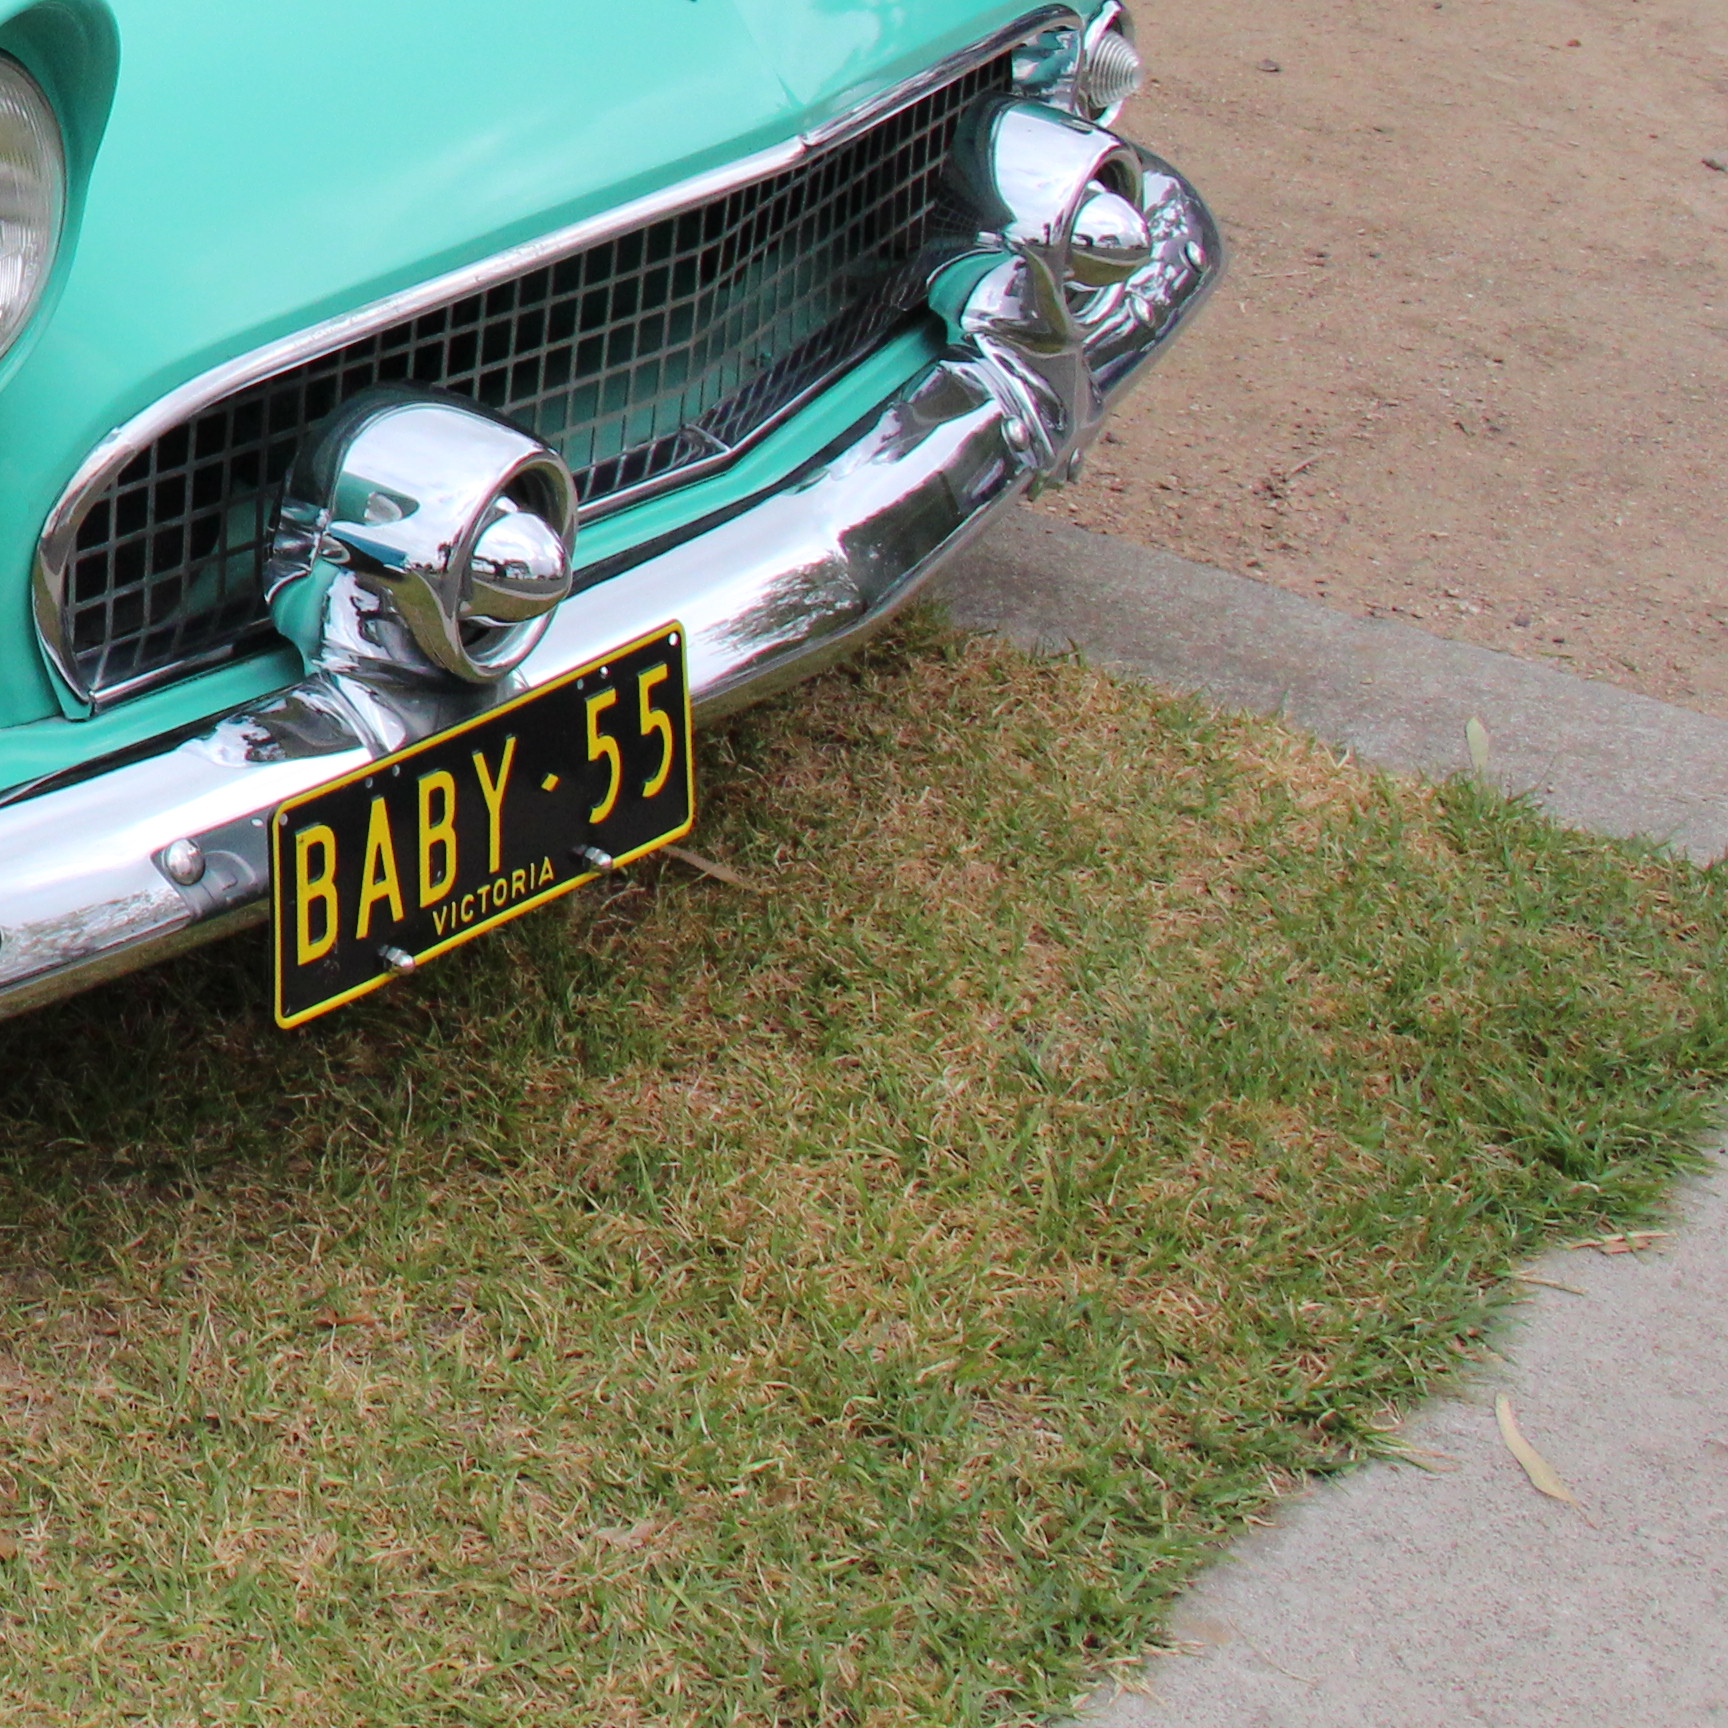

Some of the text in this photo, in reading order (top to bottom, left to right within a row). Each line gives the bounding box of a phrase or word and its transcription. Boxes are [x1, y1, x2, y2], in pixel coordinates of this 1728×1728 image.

[295, 662, 674, 967] BABY 55
[431, 856, 556, 936] VICTORIA
